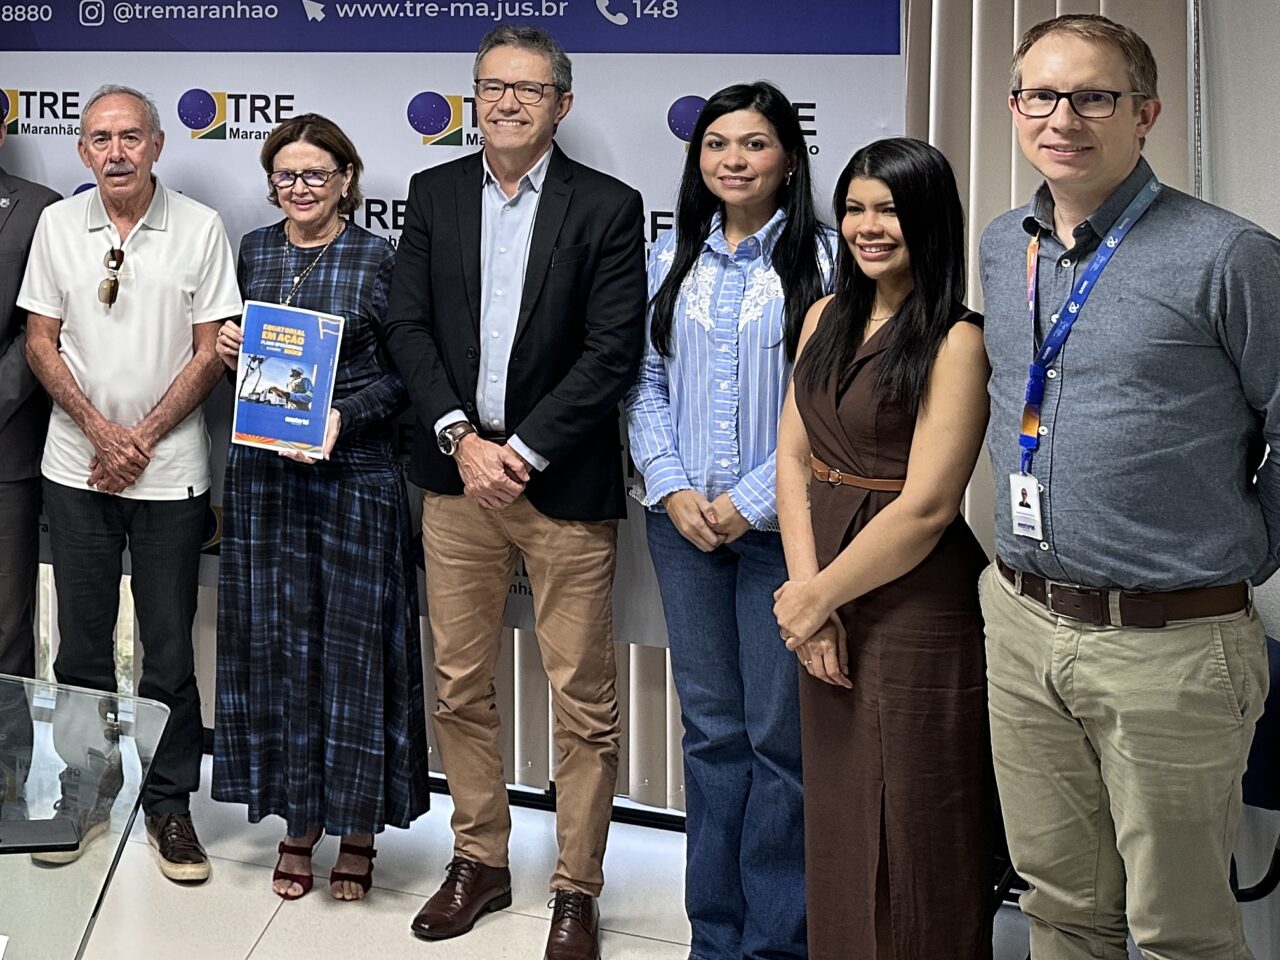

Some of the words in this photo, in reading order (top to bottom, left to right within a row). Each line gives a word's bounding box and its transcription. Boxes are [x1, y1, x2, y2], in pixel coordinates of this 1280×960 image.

[113, 0, 279, 24] @tremaranhao
[19, 91, 80, 119] TRE
[227, 94, 294, 124] TRE
[229, 128, 276, 140] Maran
